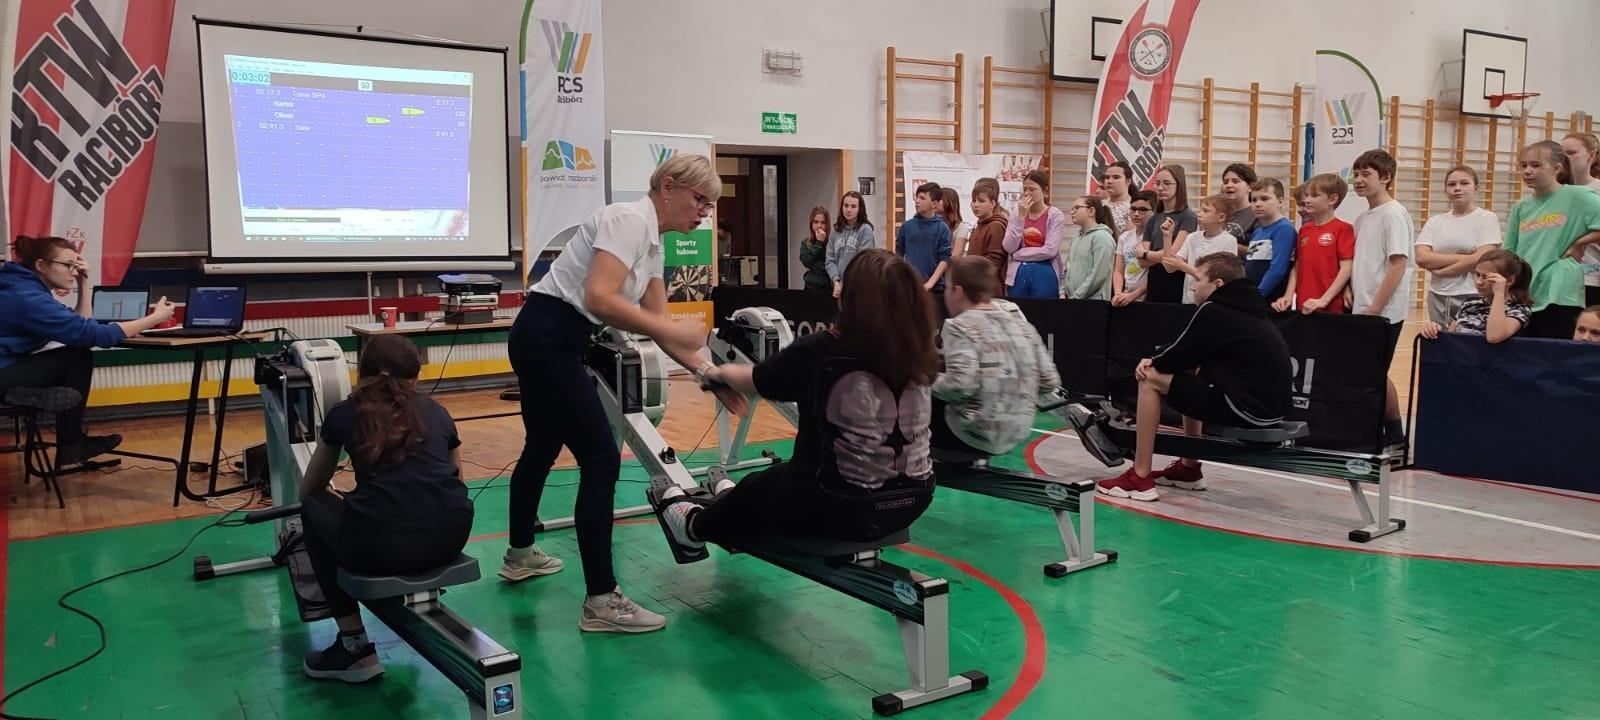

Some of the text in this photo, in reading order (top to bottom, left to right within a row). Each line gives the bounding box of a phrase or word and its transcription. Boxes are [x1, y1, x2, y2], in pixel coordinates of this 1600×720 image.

[231, 71, 270, 82] 0:03:02
[557, 76, 583, 94] PCS
[10, 0, 139, 182] KTW
[66, 227, 86, 239] PZK
[675, 239, 697, 249] Sporty
[676, 248, 699, 256] halowe
